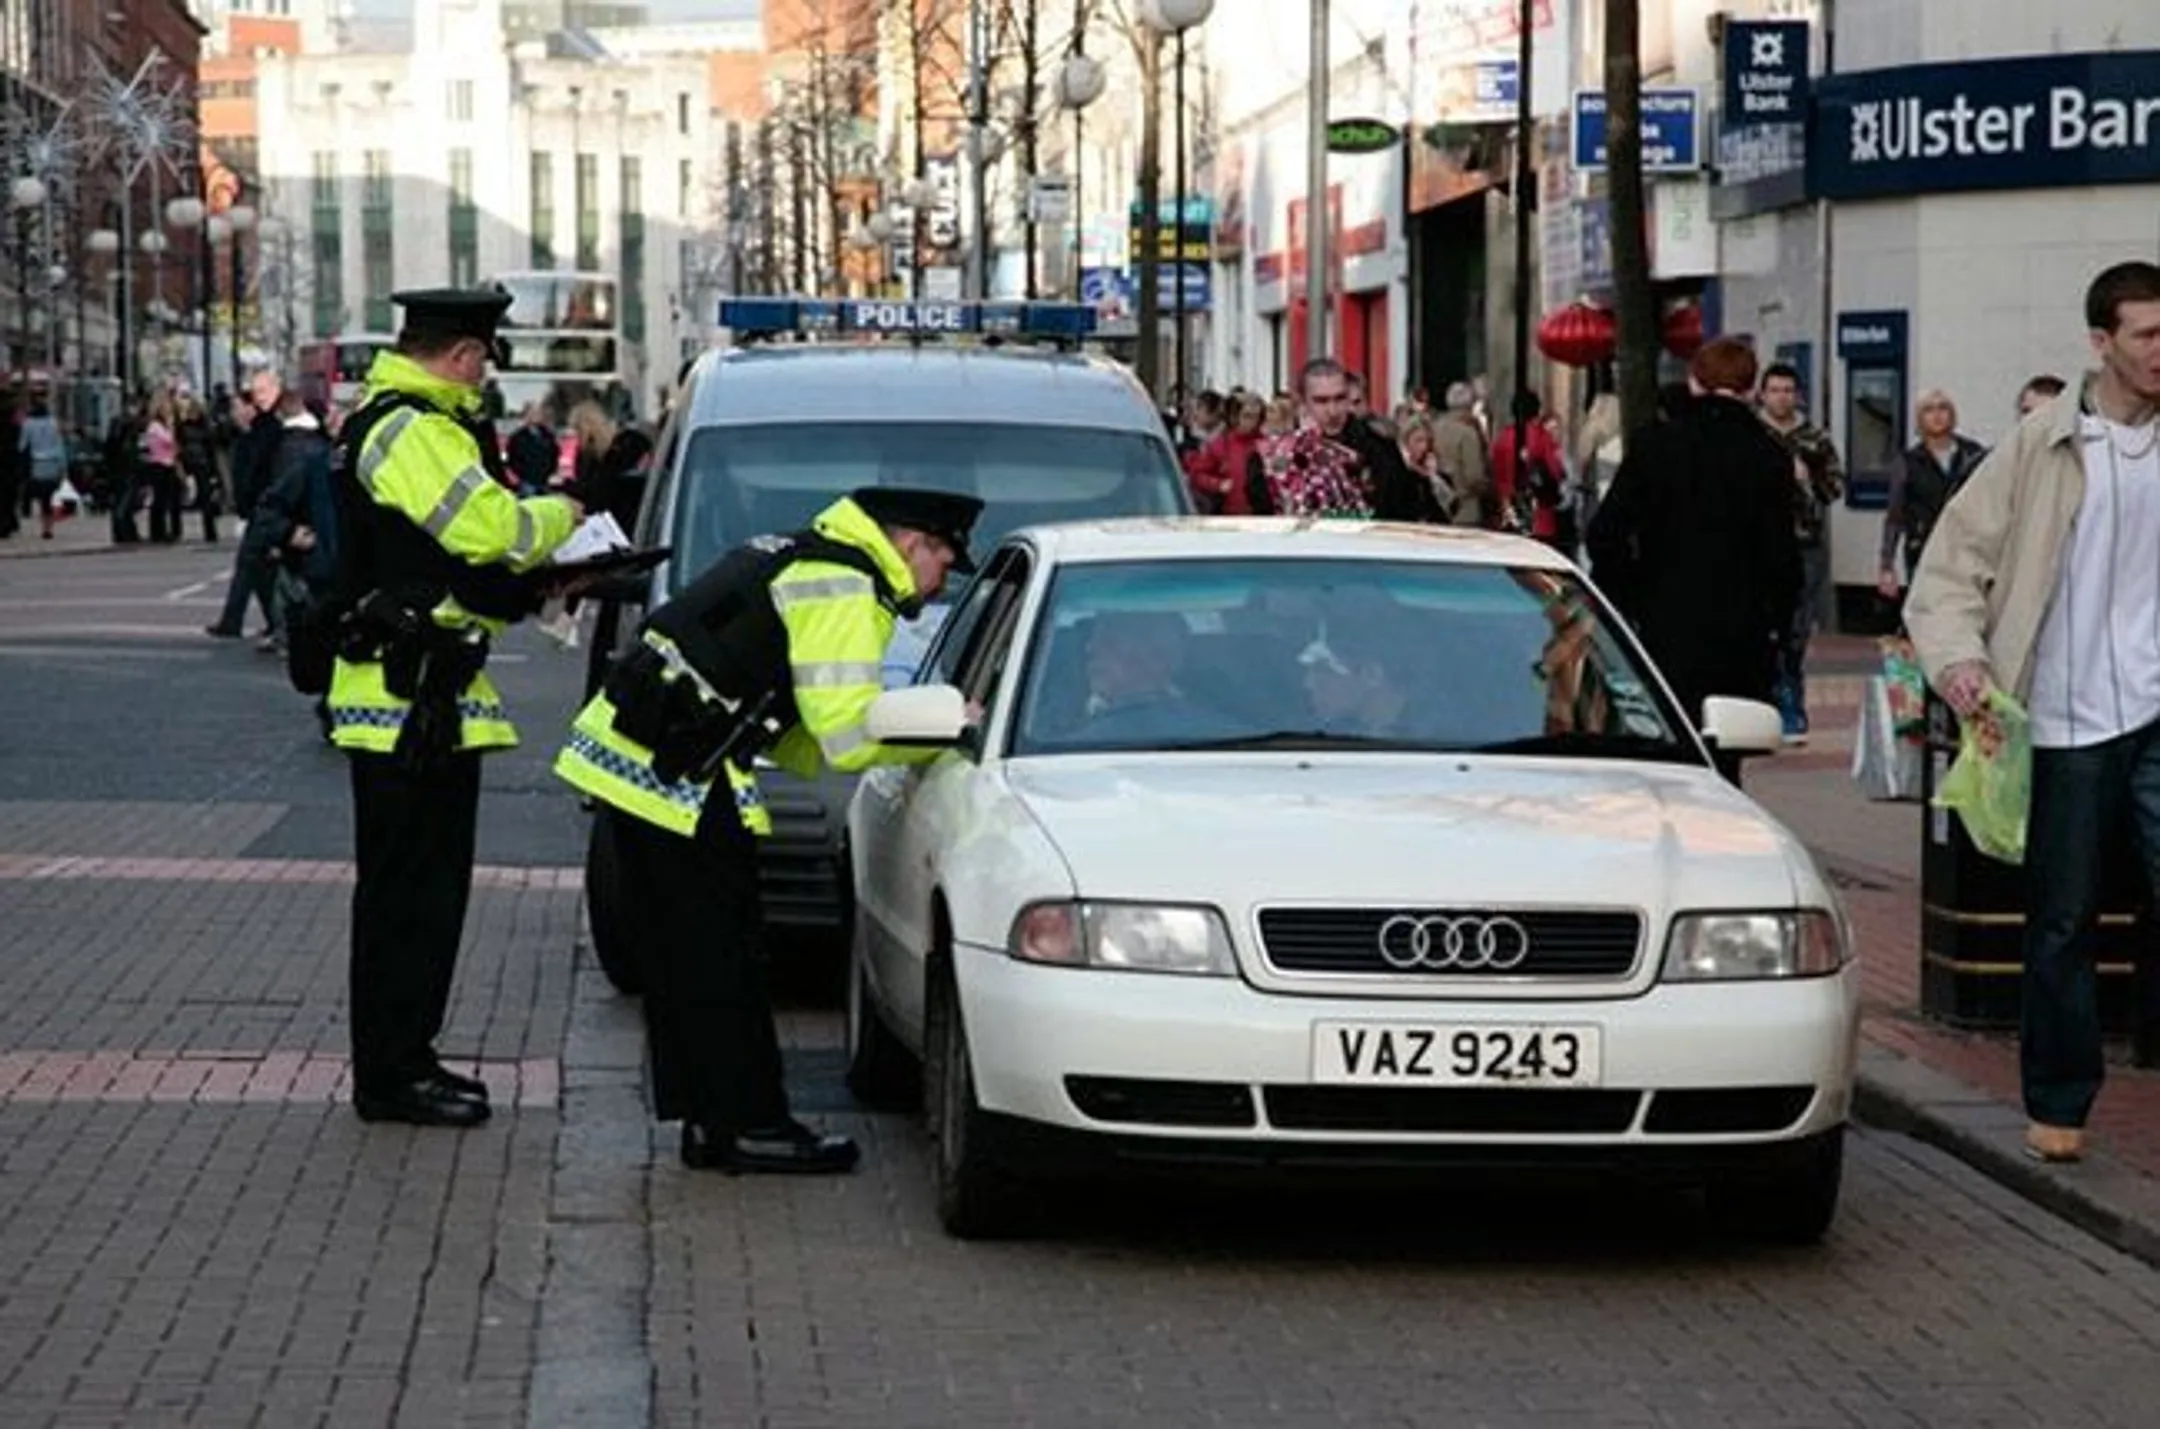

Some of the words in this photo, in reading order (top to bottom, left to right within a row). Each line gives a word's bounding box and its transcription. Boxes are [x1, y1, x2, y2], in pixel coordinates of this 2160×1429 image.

[1882, 95, 2035, 159] Ulster
[857, 304, 963, 329] POLICE
[1339, 1029, 1436, 1076] VAZ
[1451, 1031, 1580, 1079] 9243
